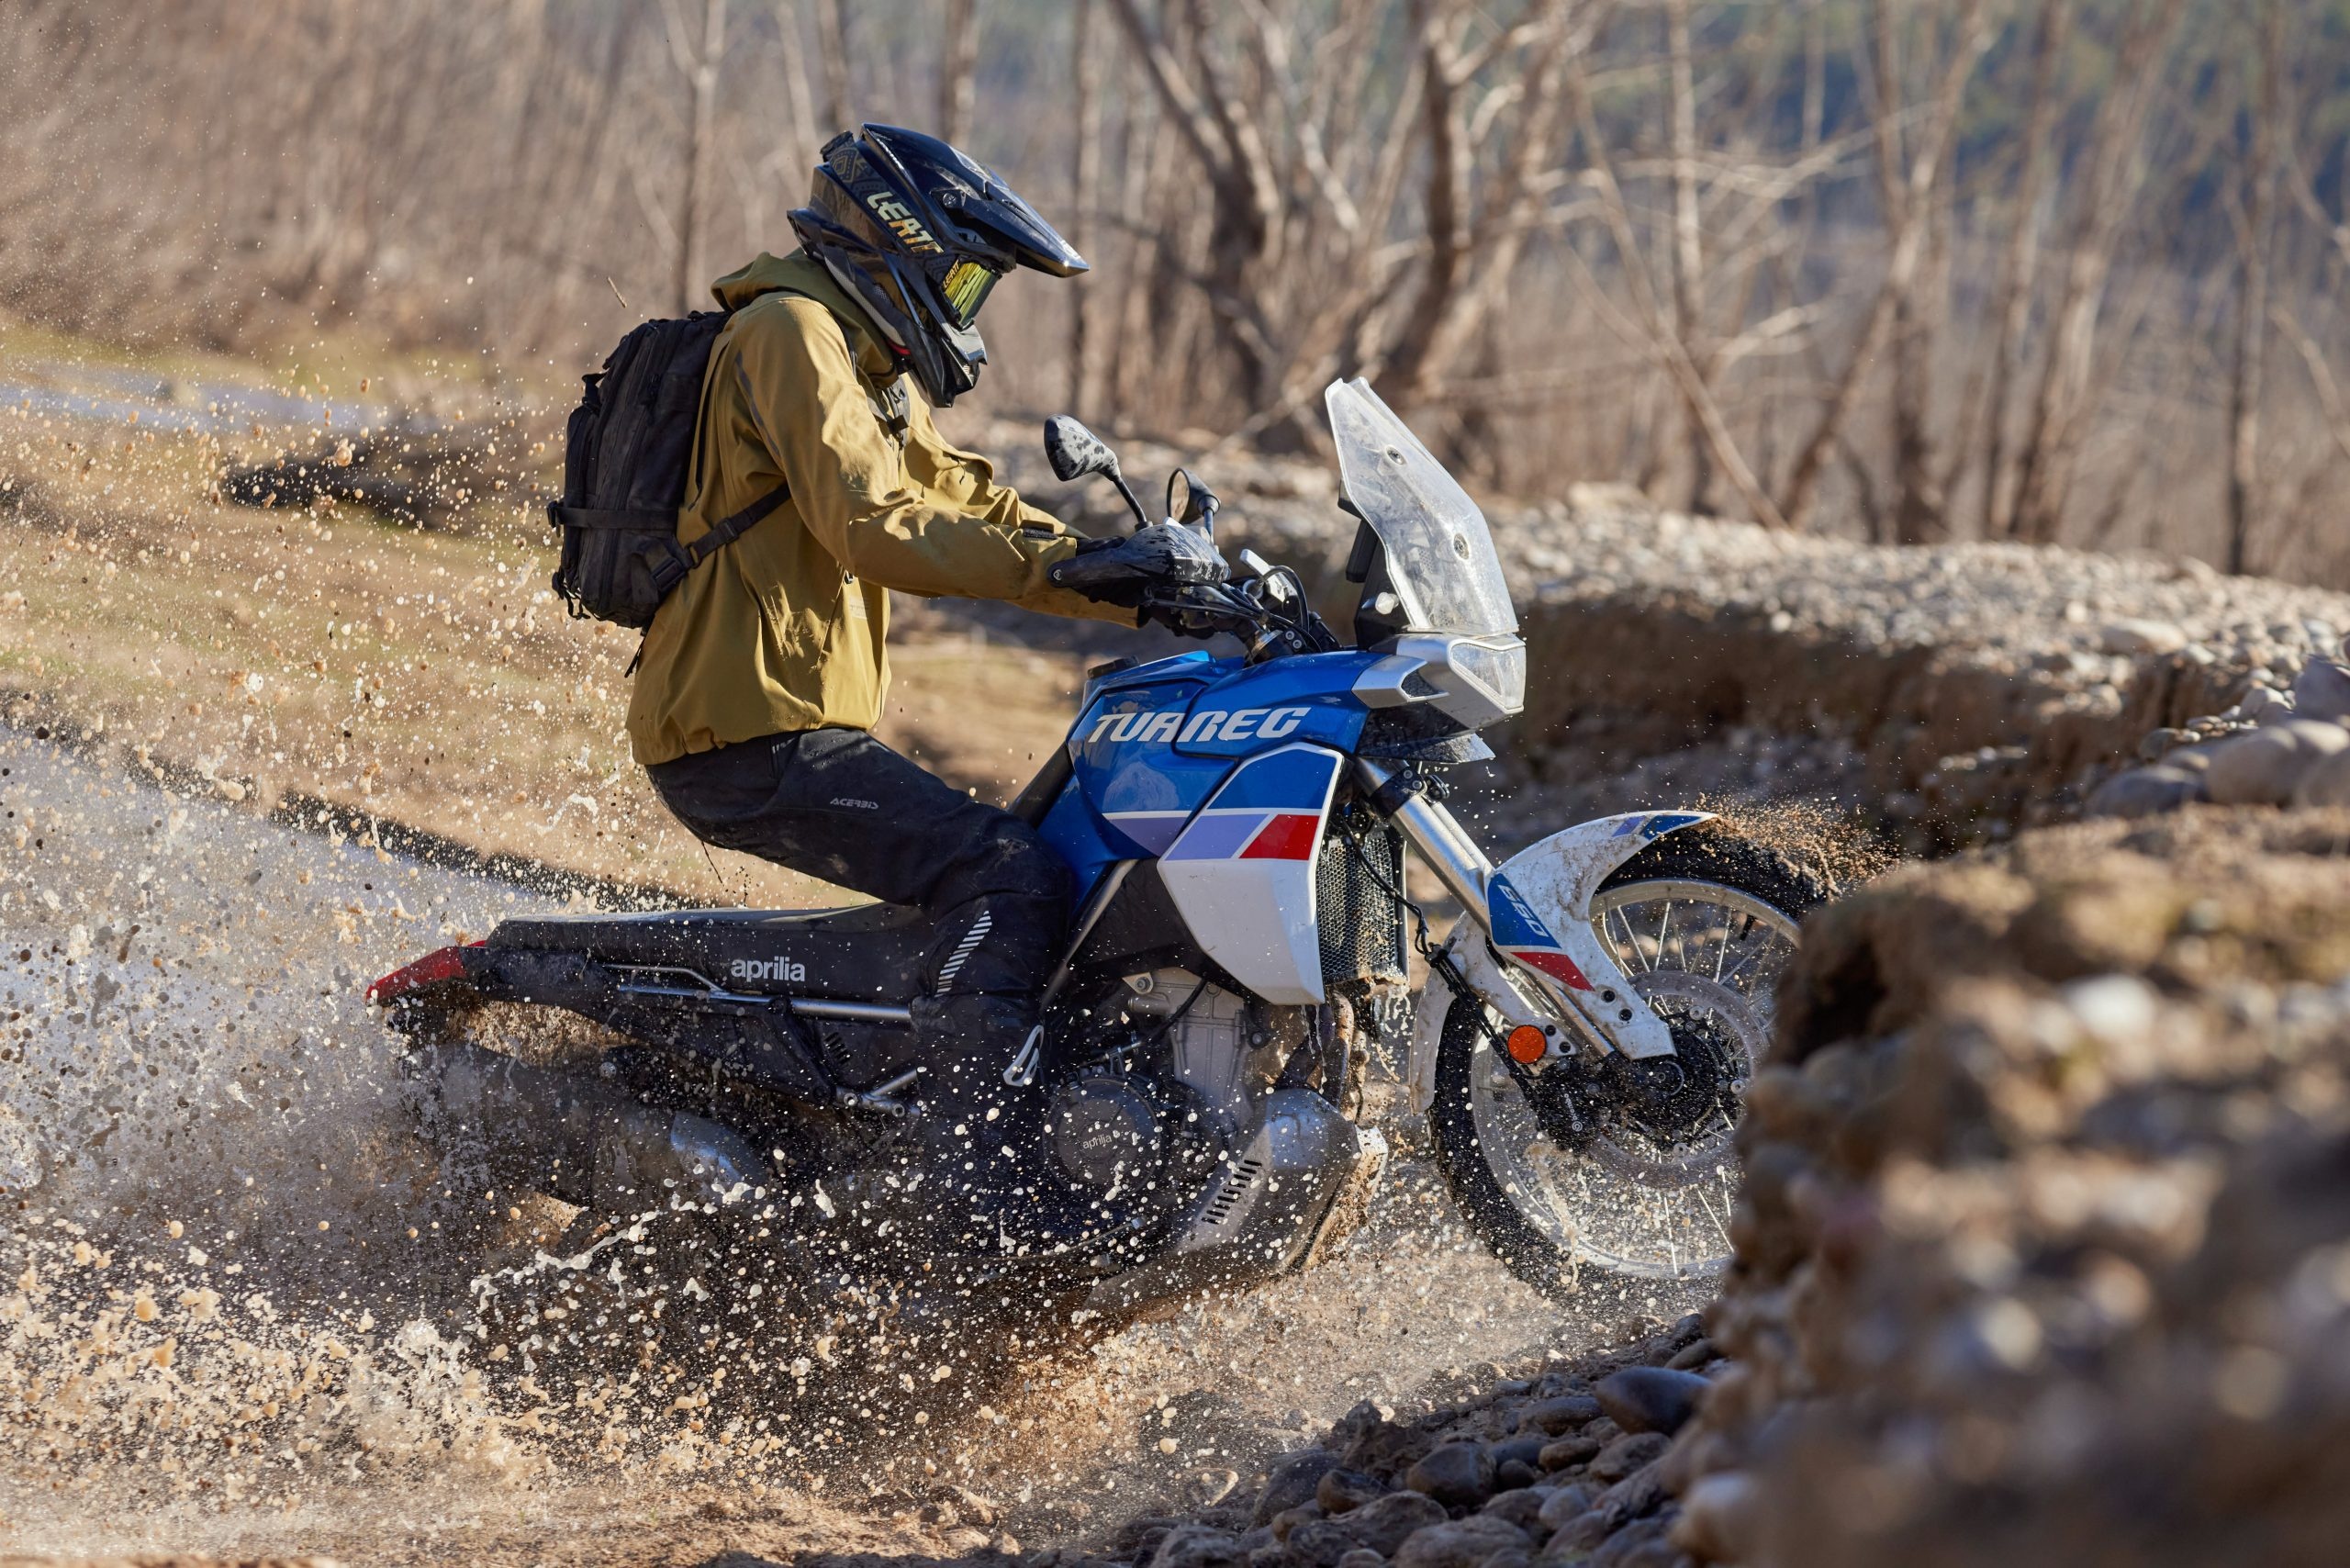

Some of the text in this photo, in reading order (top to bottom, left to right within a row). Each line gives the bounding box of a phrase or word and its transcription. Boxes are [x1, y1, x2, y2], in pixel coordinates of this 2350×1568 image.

[867, 191, 945, 254] LEATT
[943, 258, 959, 288] LEATT
[1088, 706, 1312, 744] TUAREG
[830, 797, 879, 810] ACERBIS
[1497, 884, 1550, 937] 660
[730, 956, 806, 982] aprilia
[1082, 1134, 1113, 1149] aprilia
